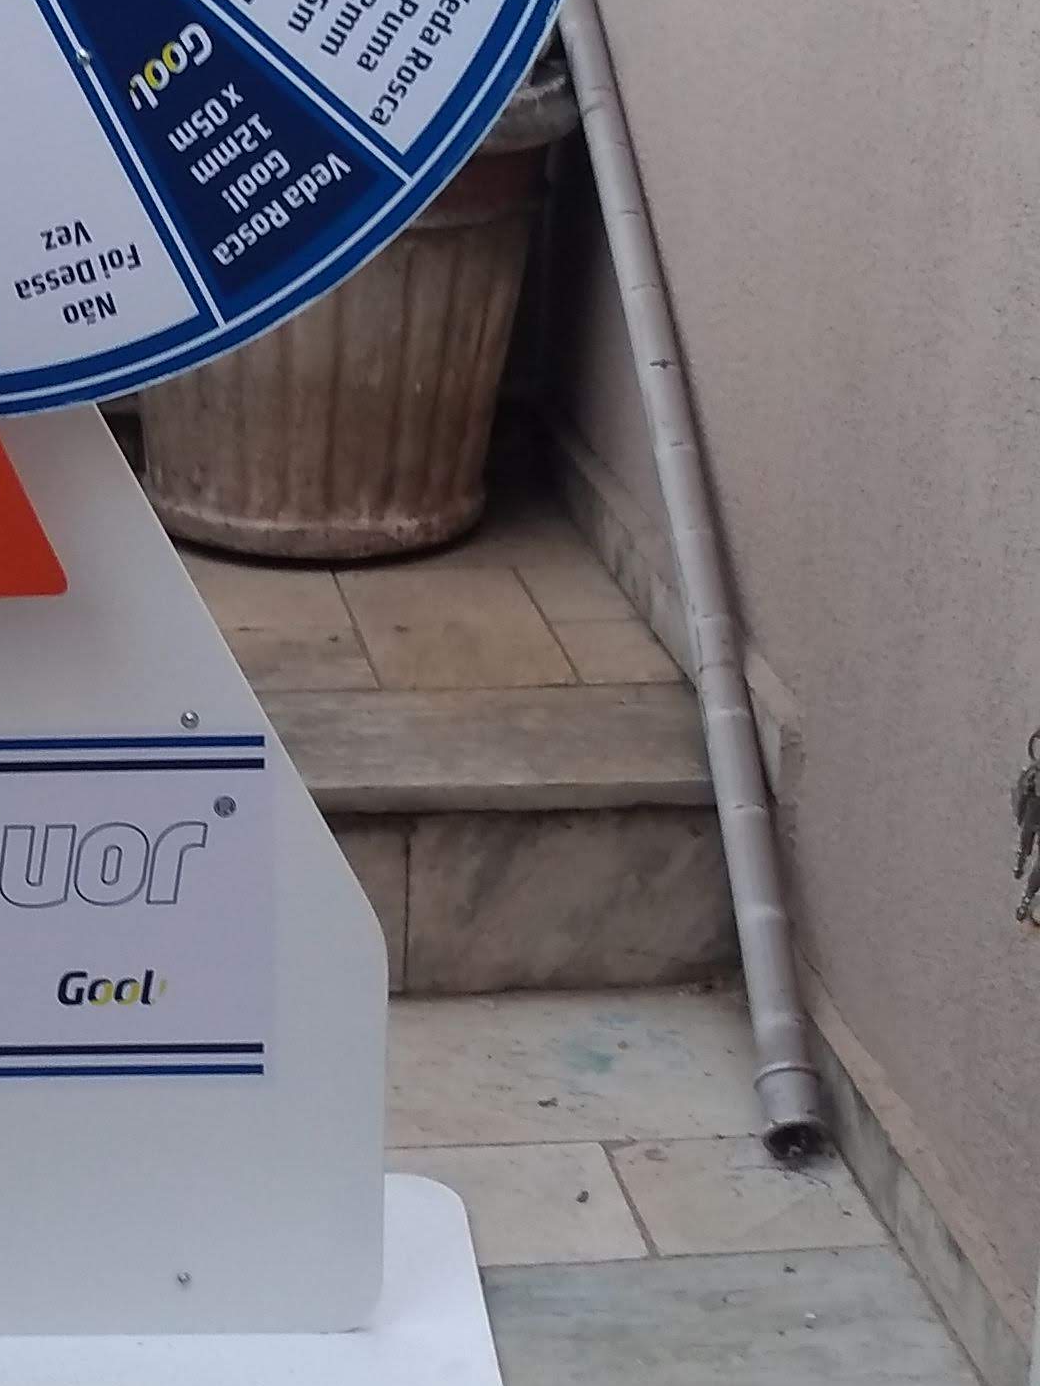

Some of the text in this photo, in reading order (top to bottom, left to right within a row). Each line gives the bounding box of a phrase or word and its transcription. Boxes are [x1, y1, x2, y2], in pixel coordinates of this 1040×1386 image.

[167, 82, 244, 152] x 05m
[368, 46, 433, 127] Rosca
[190, 113, 273, 185] 12mm
[221, 149, 291, 214] Gool!
[39, 220, 93, 251] Vez
[212, 152, 352, 265] Veda Rosca
[14, 243, 142, 300] Foi Dessa
[62, 291, 117, 326] Não
